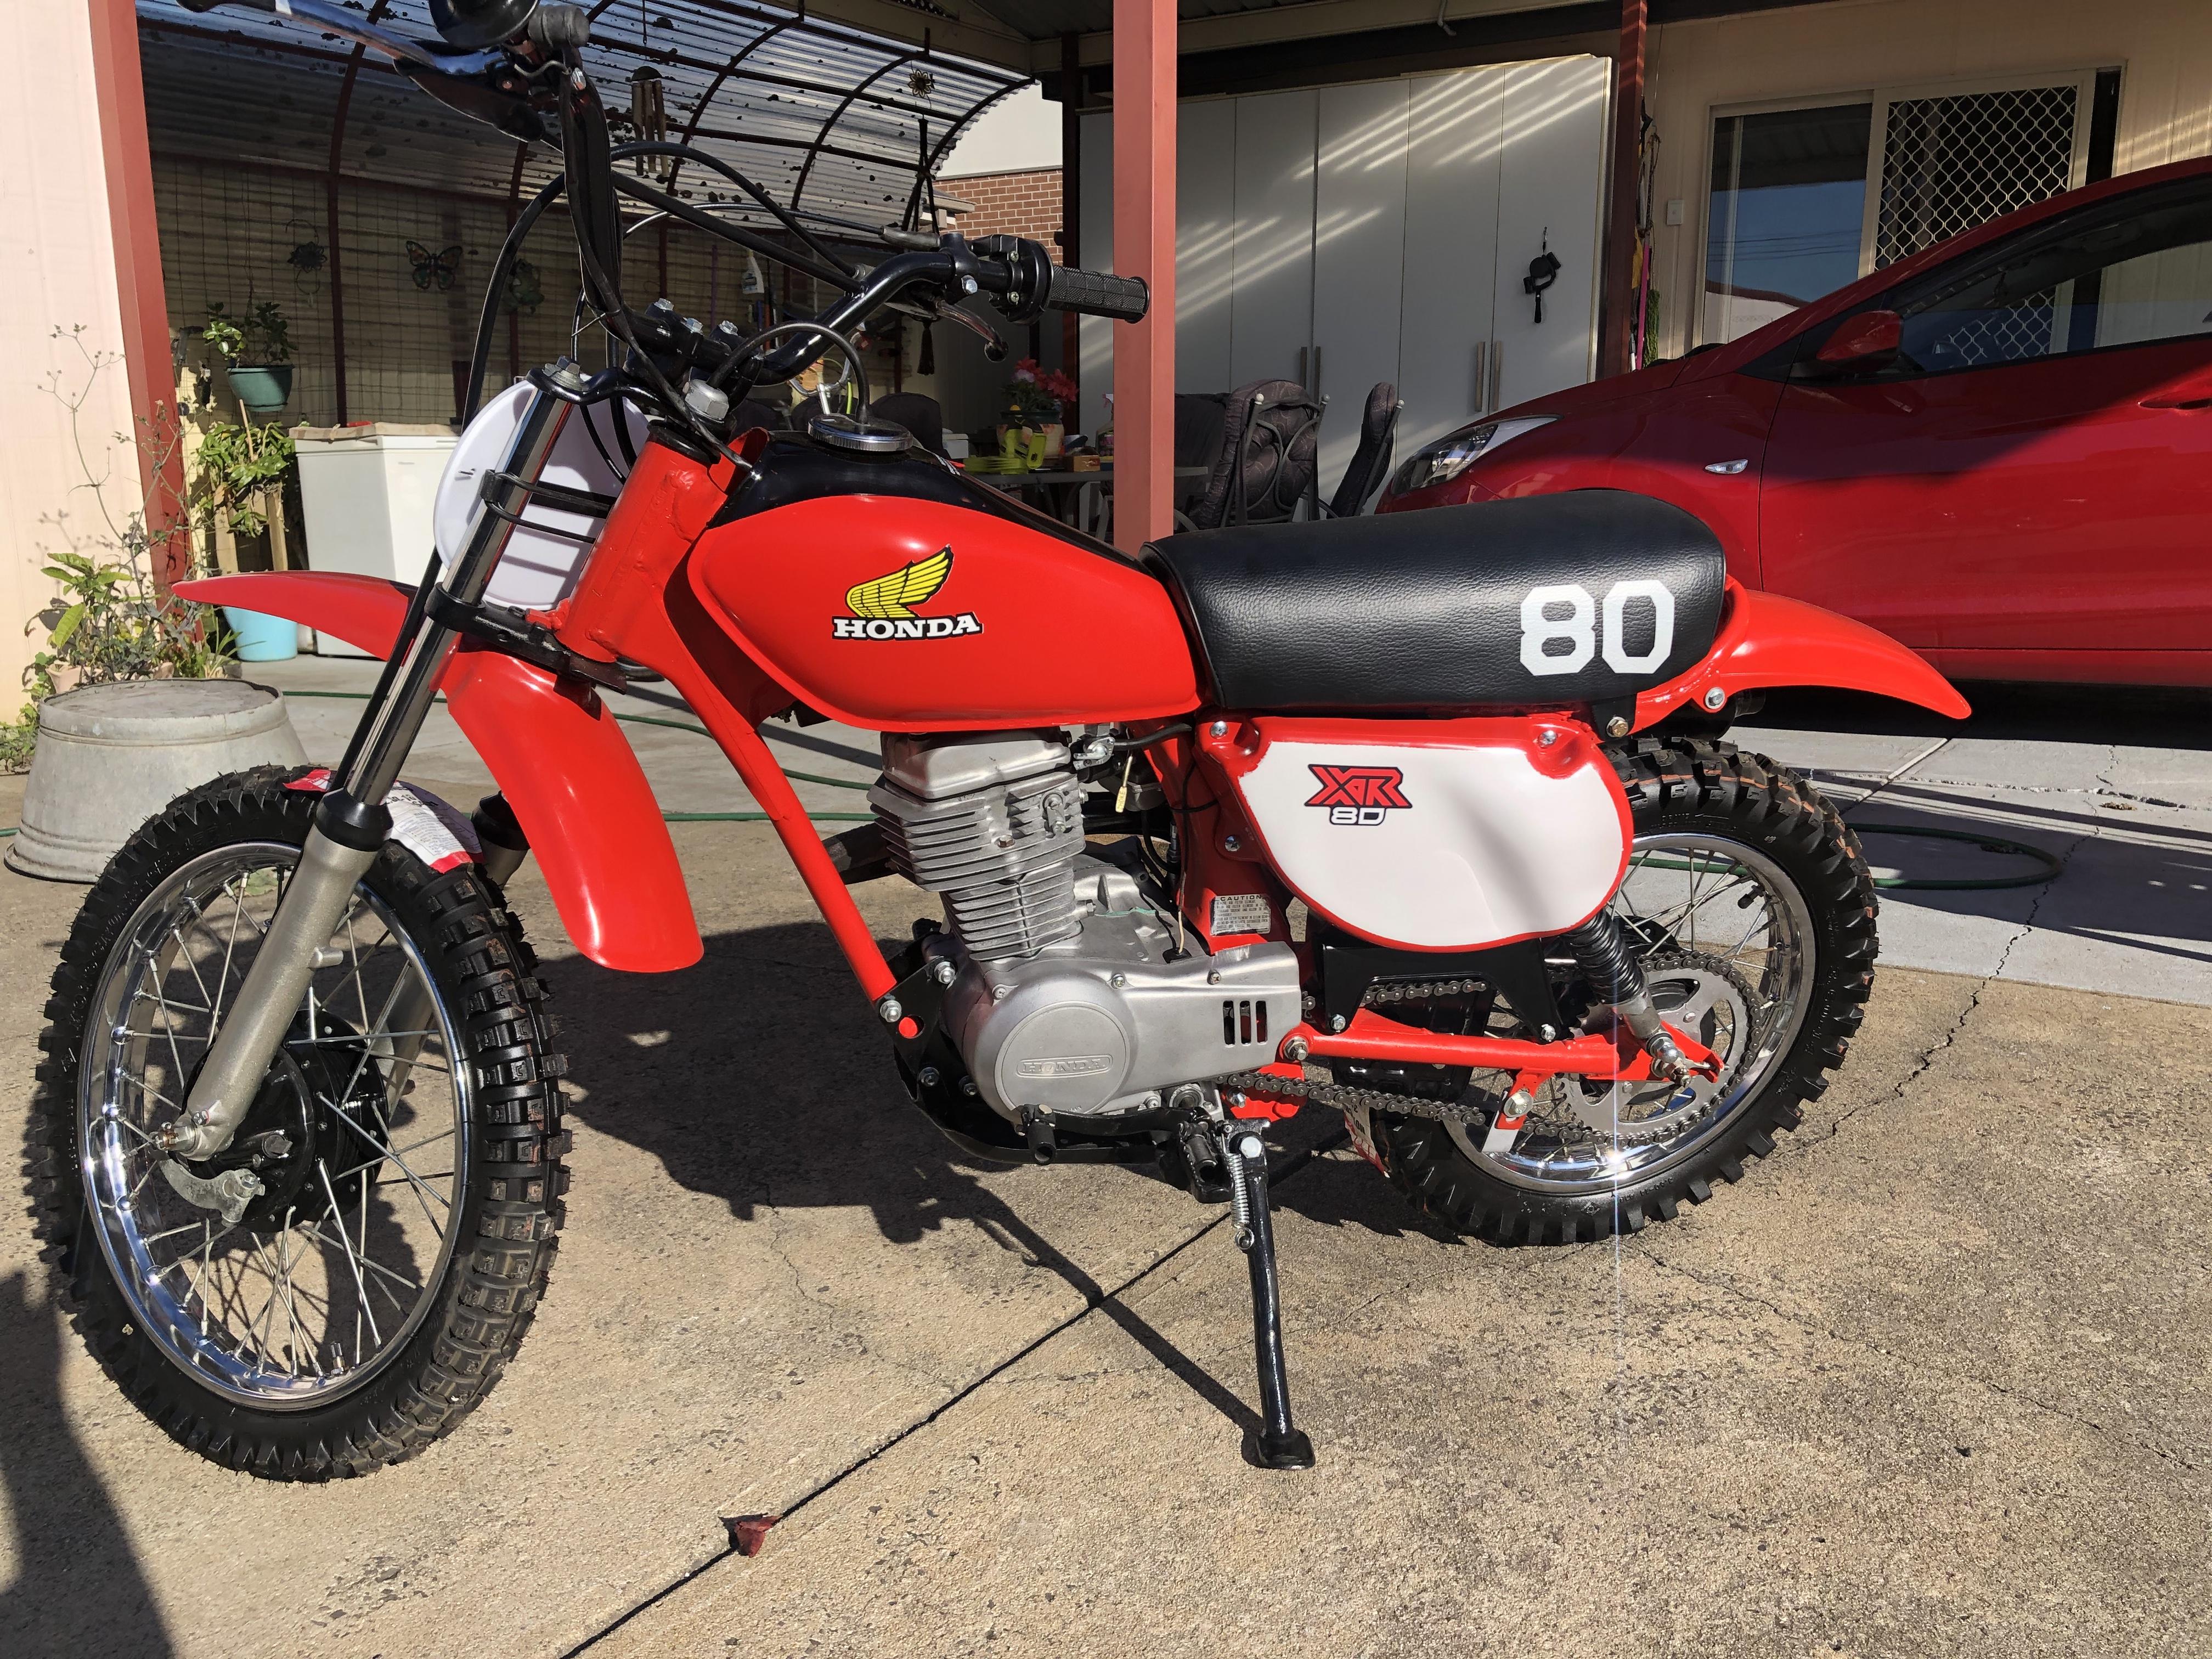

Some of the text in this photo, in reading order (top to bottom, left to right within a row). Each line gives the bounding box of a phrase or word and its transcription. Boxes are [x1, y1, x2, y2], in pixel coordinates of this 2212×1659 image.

[833, 614, 980, 639] HONDA
[1520, 579, 1675, 676] 80
[1305, 764, 1413, 808] XR
[1023, 1058, 1106, 1074] HONDA
